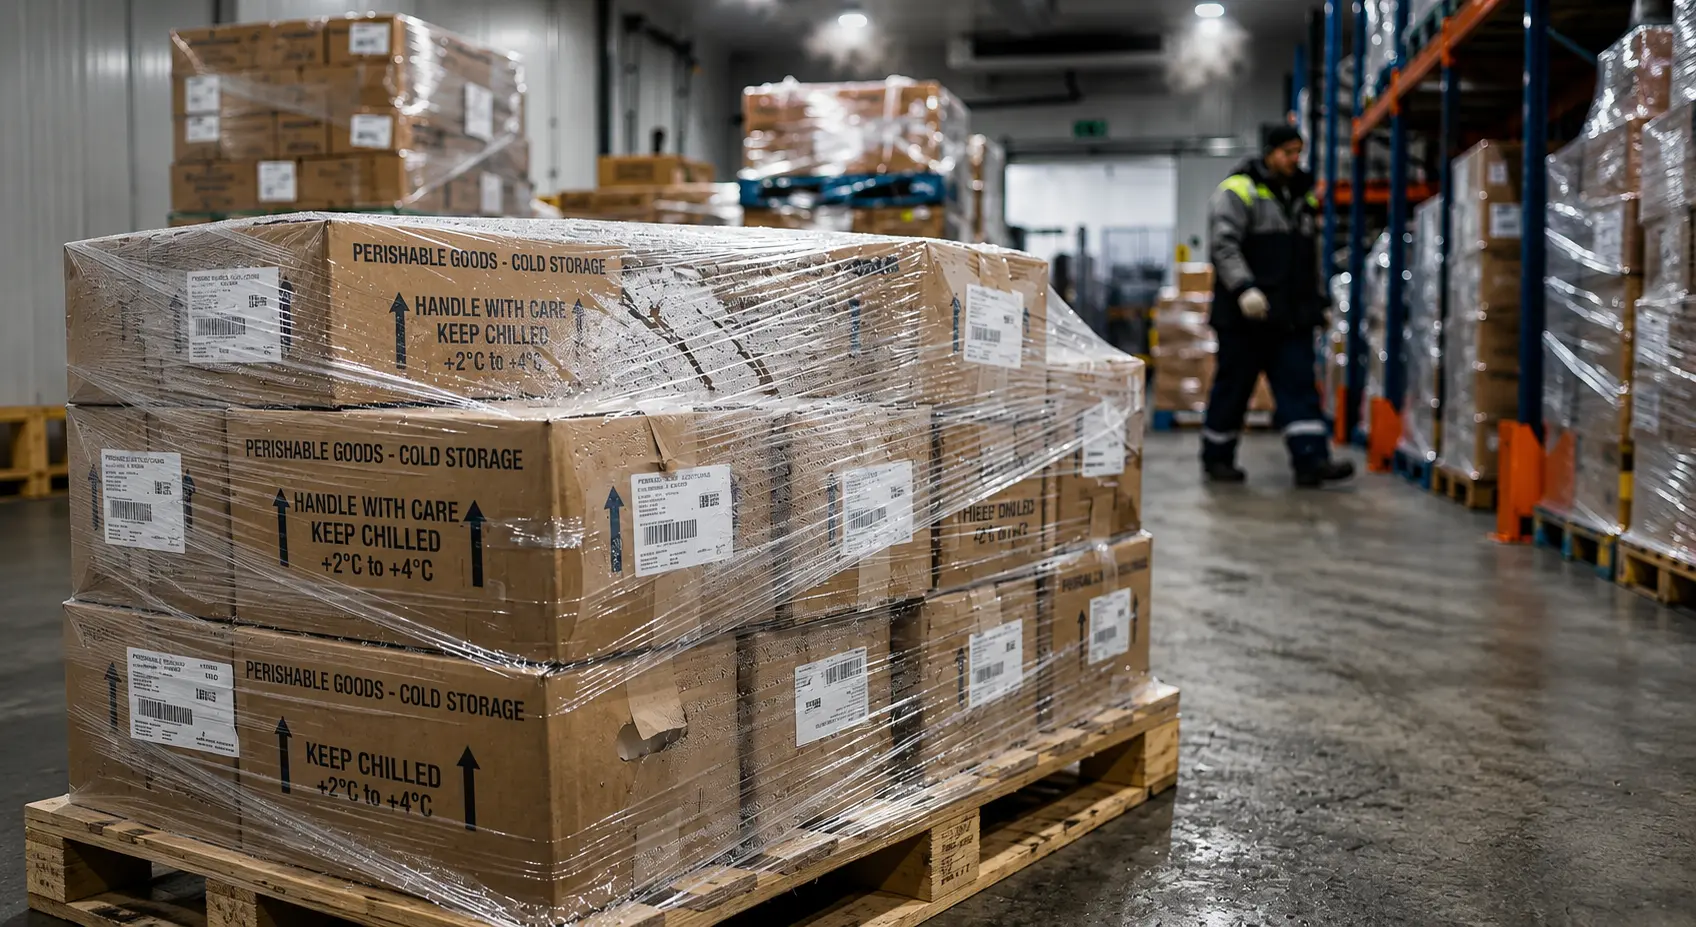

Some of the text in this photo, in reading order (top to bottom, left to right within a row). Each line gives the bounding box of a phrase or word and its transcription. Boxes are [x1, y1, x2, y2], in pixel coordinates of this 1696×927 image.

[353, 243, 446, 267] PERISHABLE
[451, 250, 498, 270] GOODS
[512, 254, 546, 273] COLD
[550, 256, 606, 275] STORAGE
[415, 296, 566, 319] HANDLE WITH CARE
[437, 323, 549, 345] KEEP CHILLED
[489, 353, 503, 371] to
[246, 439, 329, 461] PERISHABLE
[334, 442, 384, 464] GOODS
[399, 444, 440, 467] COLD
[445, 447, 524, 471] STORAGE
[294, 491, 459, 523] HANDLE WITH CARE
[311, 521, 441, 552] KEEP CHILLED
[368, 555, 384, 577] to
[246, 660, 329, 691] PERISHABLE
[334, 674, 384, 700] GOODS
[400, 684, 440, 709] COLD
[446, 691, 525, 722] STORAGE
[306, 741, 441, 789] KEEP CHILLED
[364, 784, 381, 806] to
